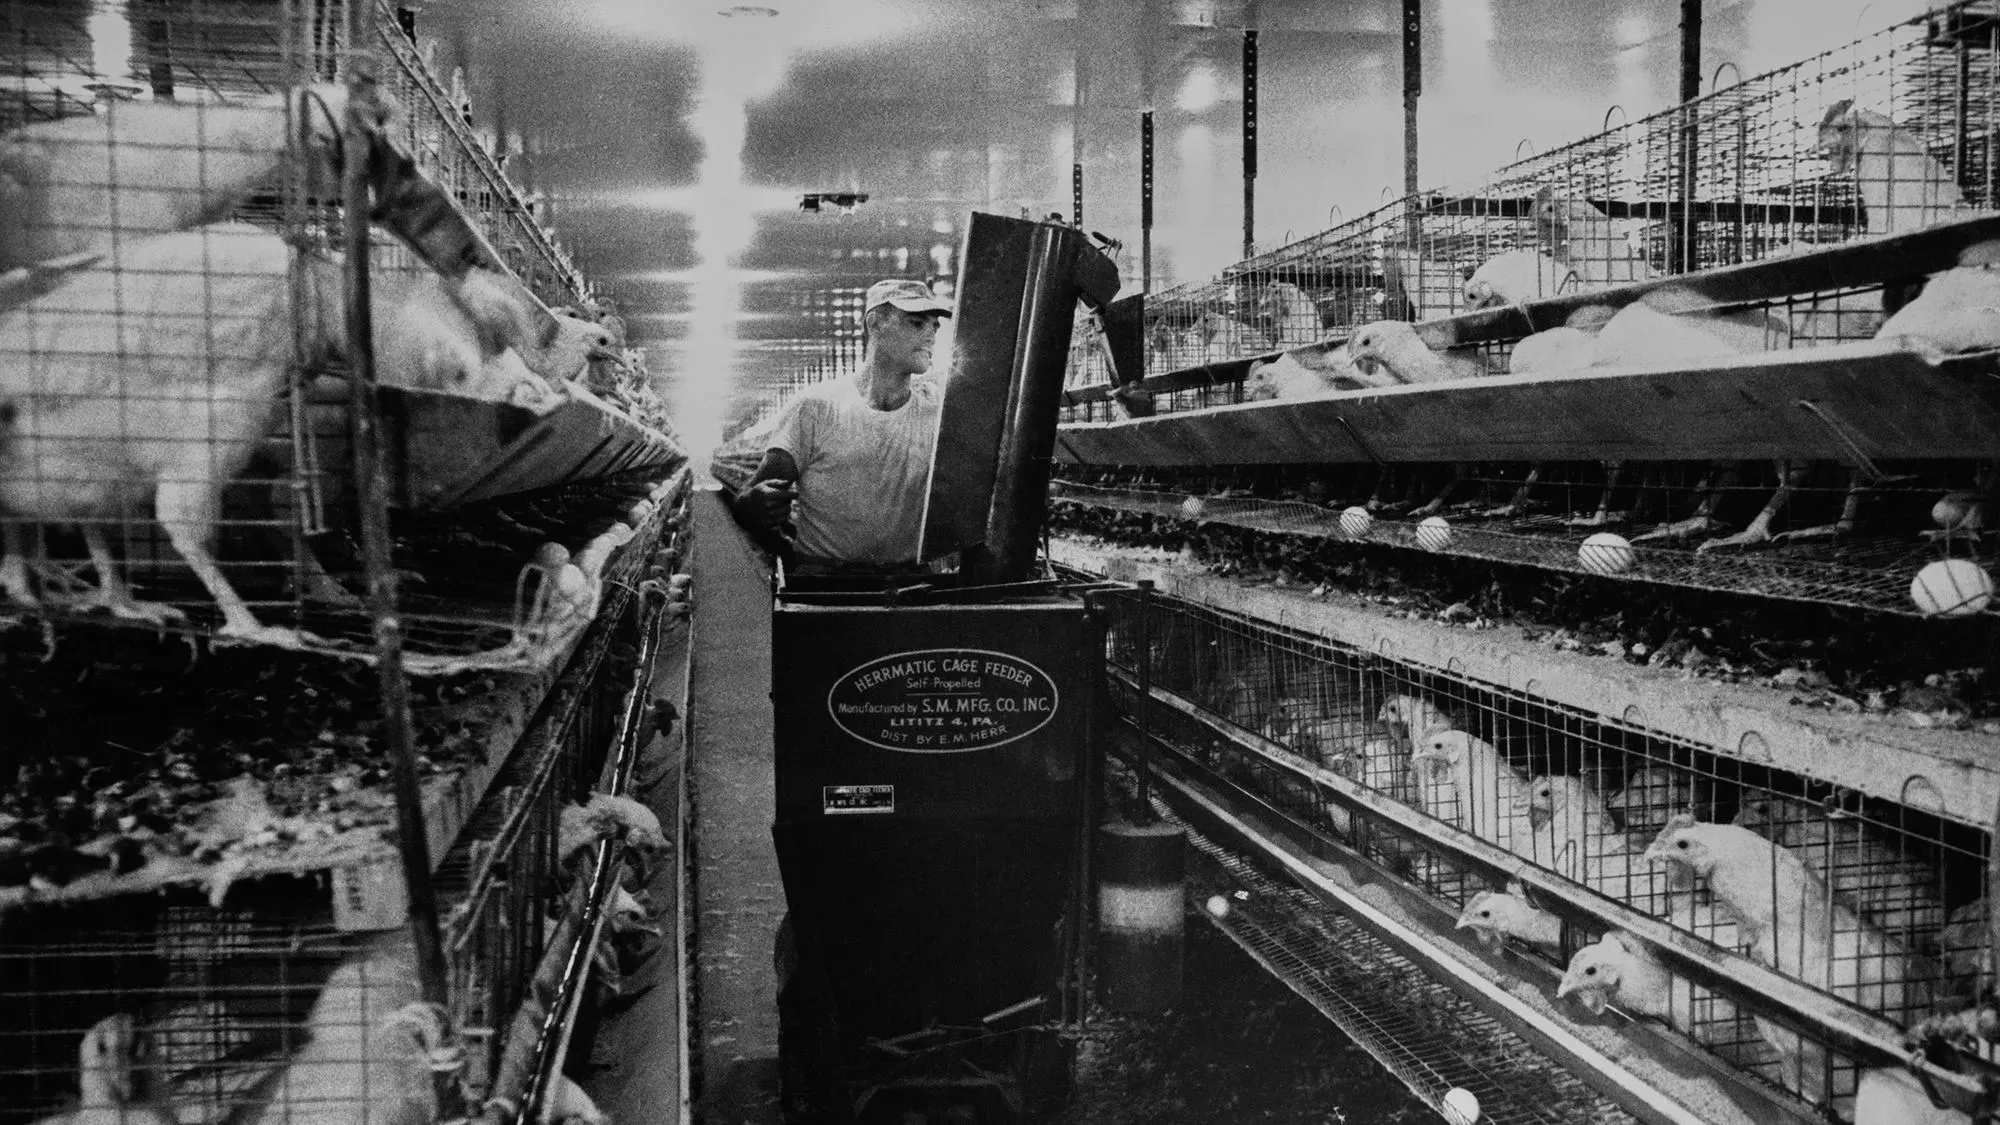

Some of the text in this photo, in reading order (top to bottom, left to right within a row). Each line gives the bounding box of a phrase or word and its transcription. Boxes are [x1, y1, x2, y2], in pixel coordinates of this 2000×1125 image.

[854, 659, 1033, 693] HERRMATIC CAGE FEEDER
[838, 702, 905, 713] Manufactured
[907, 703, 917, 716] by
[956, 698, 992, 713] MFG.
[1023, 697, 1050, 711] INC.
[890, 717, 944, 727] LITITZ
[972, 717, 998, 726] PA.
[916, 735, 933, 744] BY
[970, 725, 1008, 741] HERR
